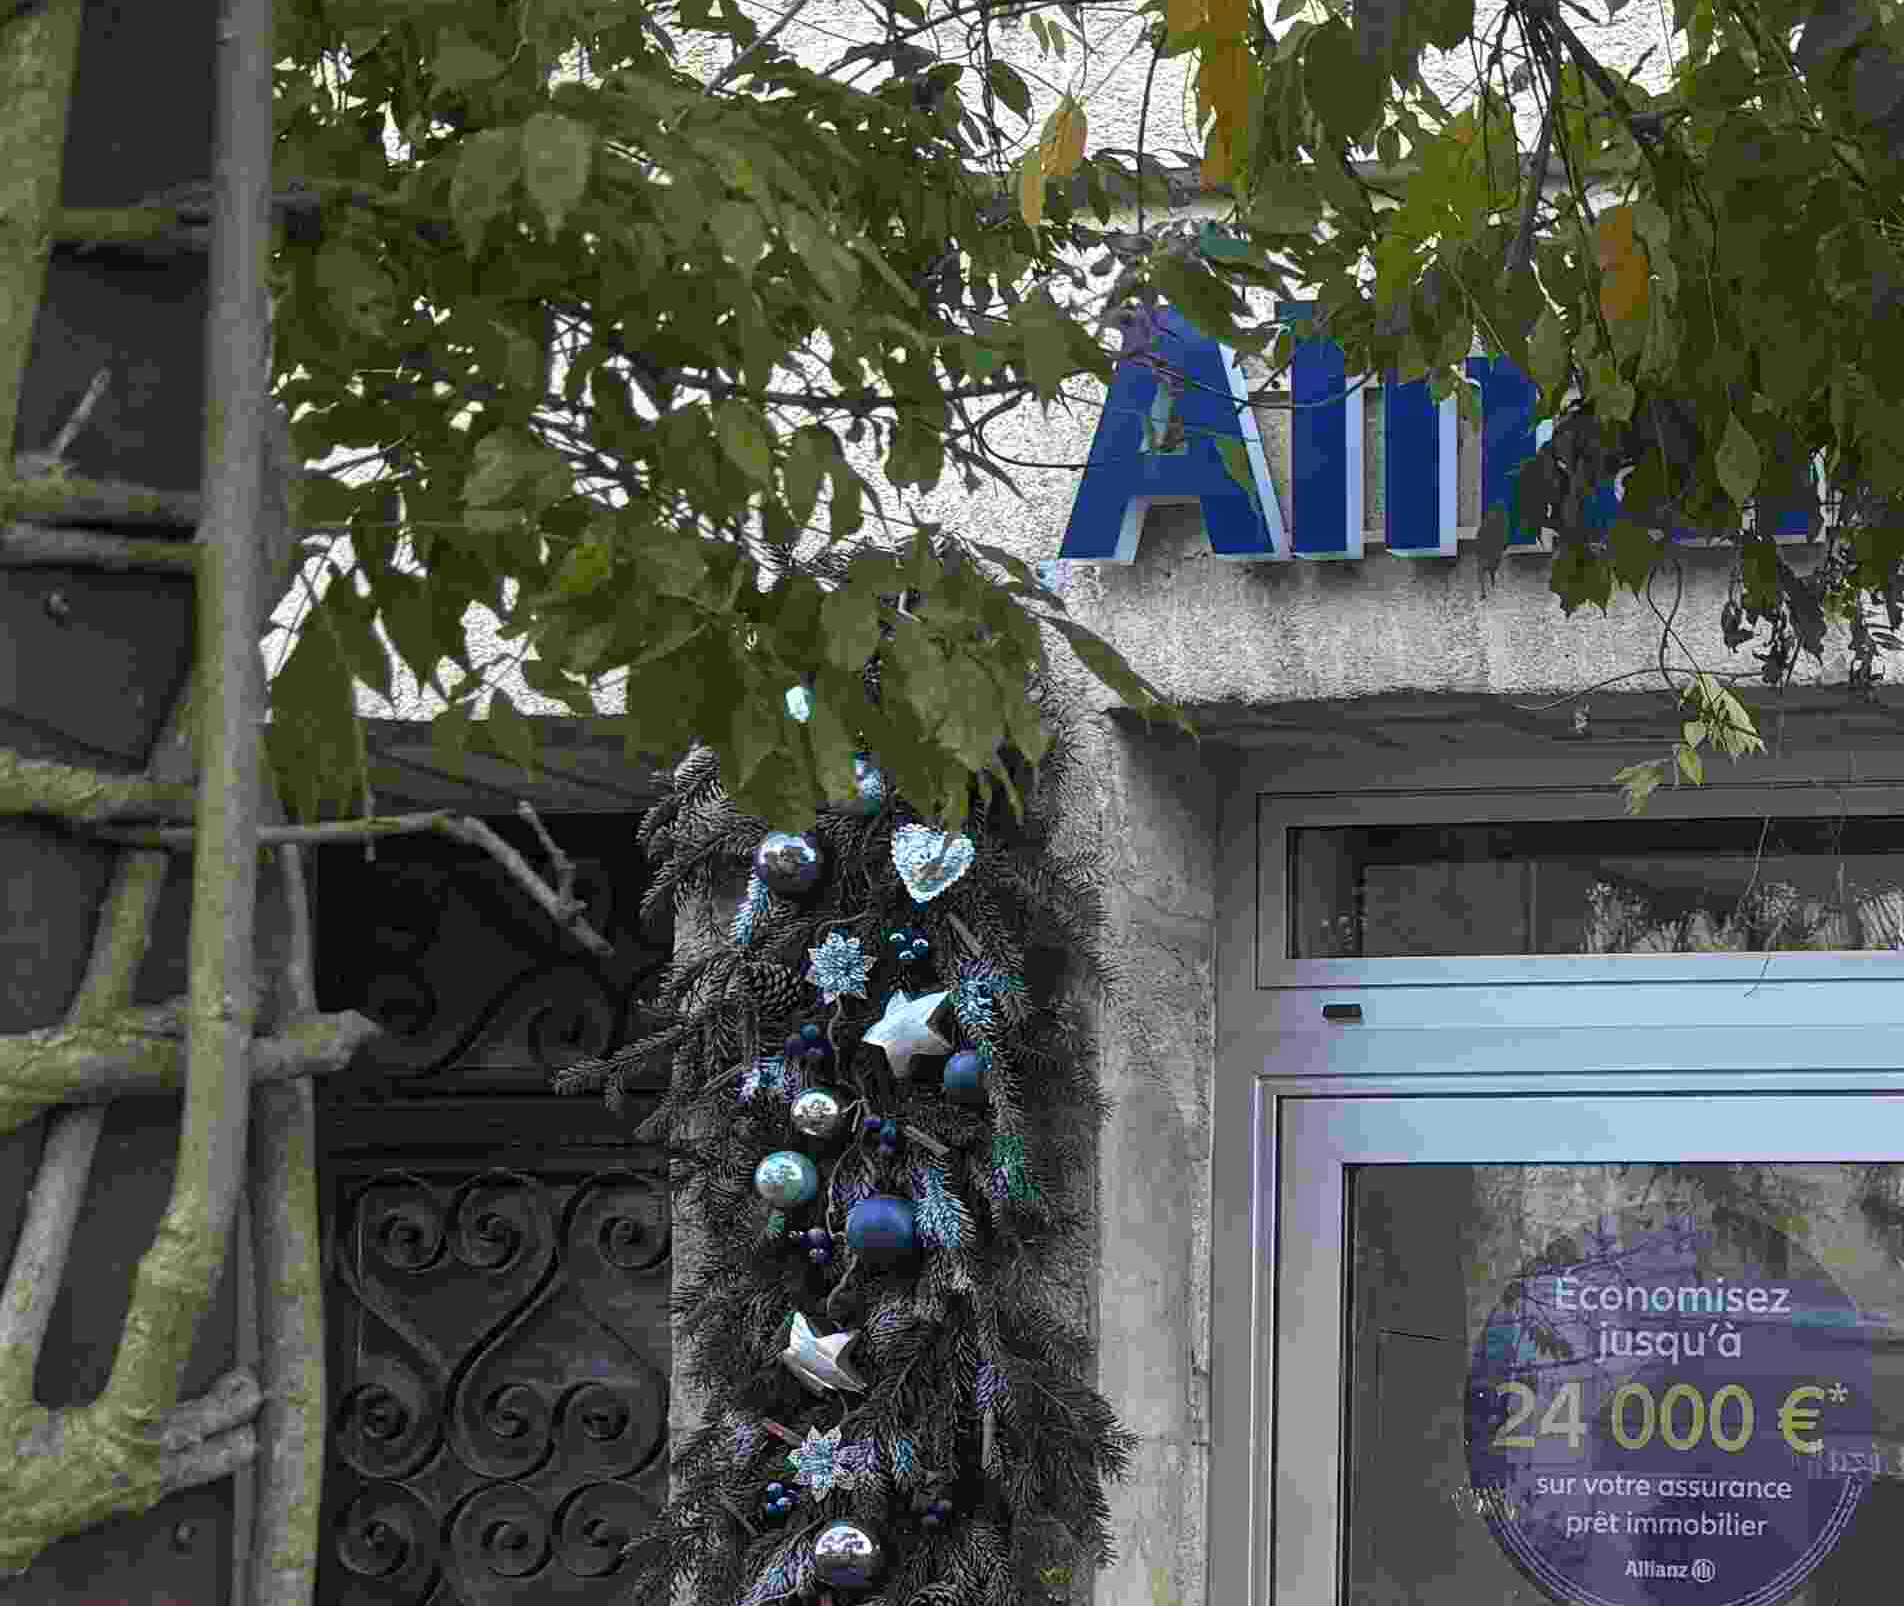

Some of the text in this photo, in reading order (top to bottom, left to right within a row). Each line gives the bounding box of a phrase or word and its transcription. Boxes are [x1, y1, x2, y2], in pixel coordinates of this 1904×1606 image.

[1553, 1276, 1792, 1314] Économisez
[1599, 1322, 1742, 1365] jusqu’à
[1491, 1381, 1587, 1449] 24
[1609, 1382, 1754, 1451] 000
[1535, 1476, 1792, 1500] sur votre assurance
[1566, 1512, 1768, 1538] prêt immobilier
[1624, 1558, 1688, 1579] Allianz
